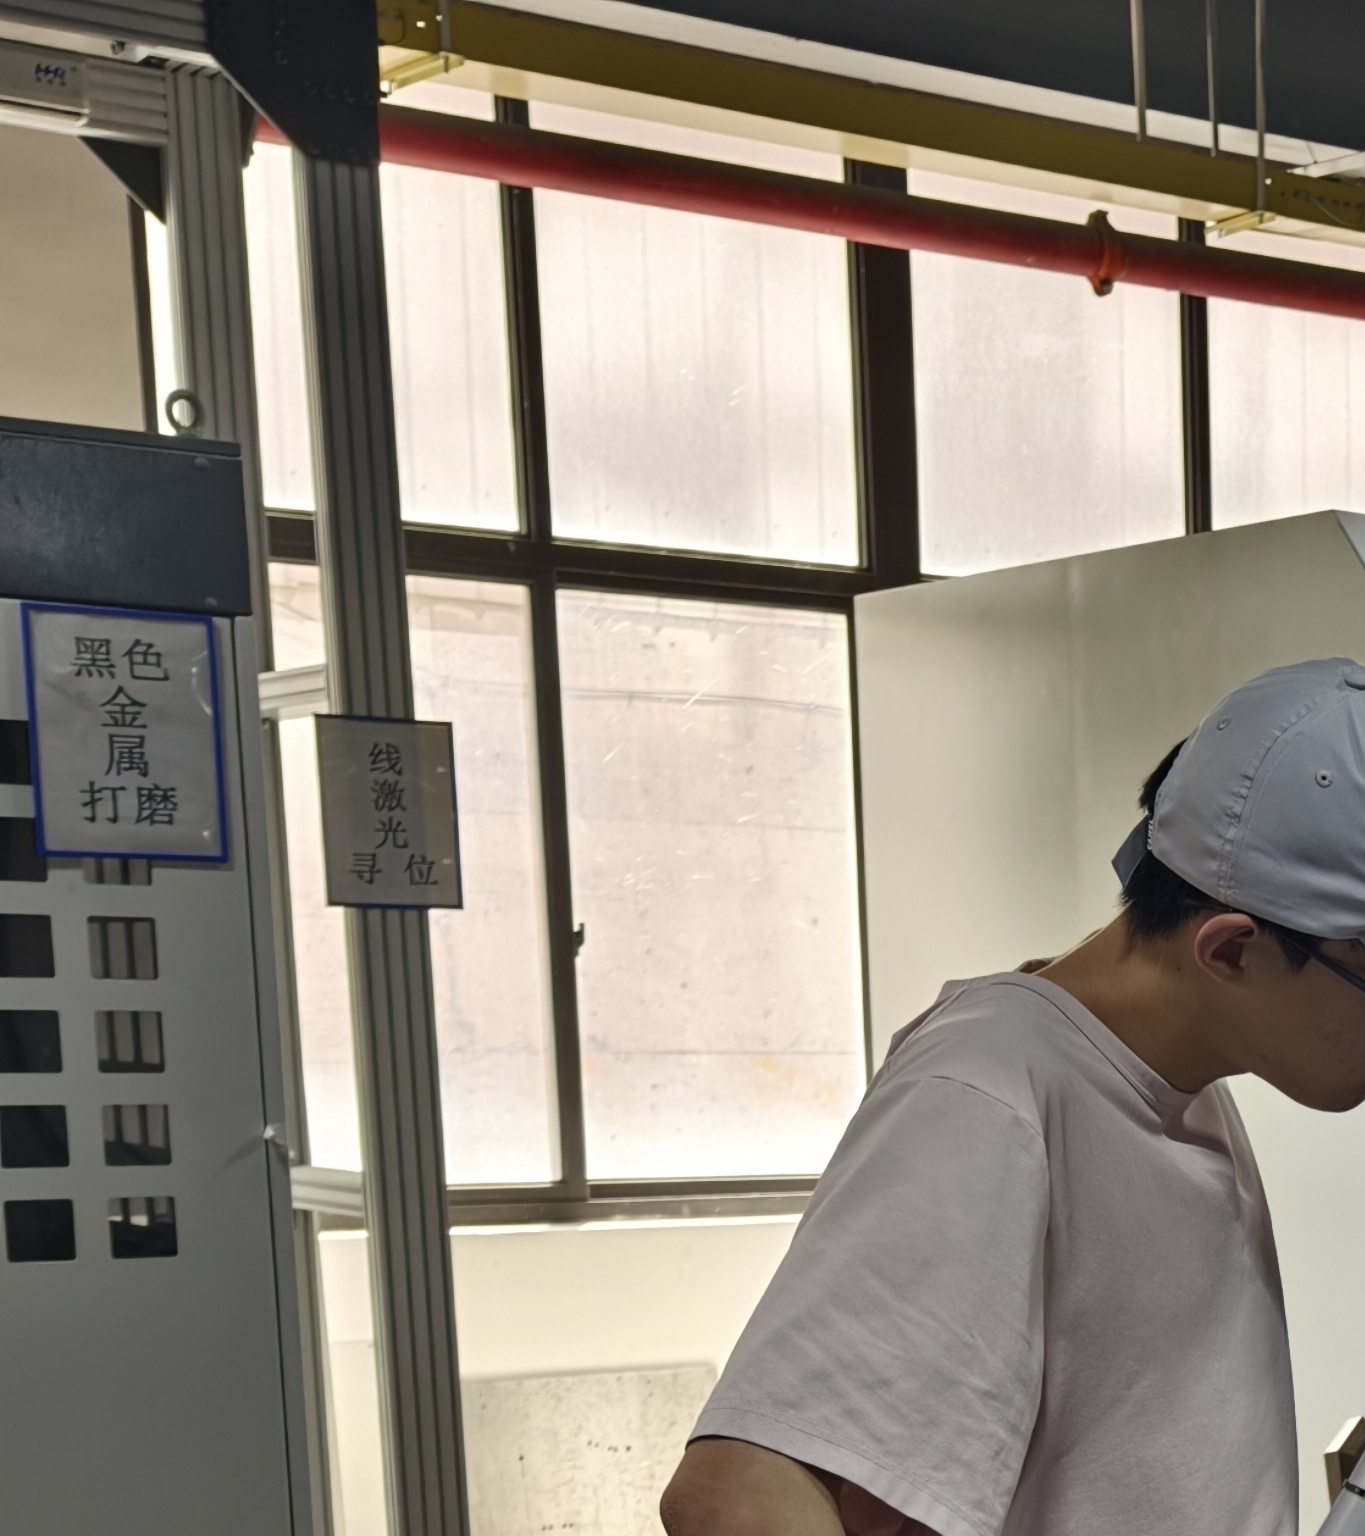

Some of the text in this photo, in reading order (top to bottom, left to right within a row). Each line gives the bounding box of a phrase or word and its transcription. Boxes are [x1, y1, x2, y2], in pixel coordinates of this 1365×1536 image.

[72, 637, 170, 682] 黑色
[80, 780, 178, 827] 打磨
[349, 852, 439, 886] 寻位
